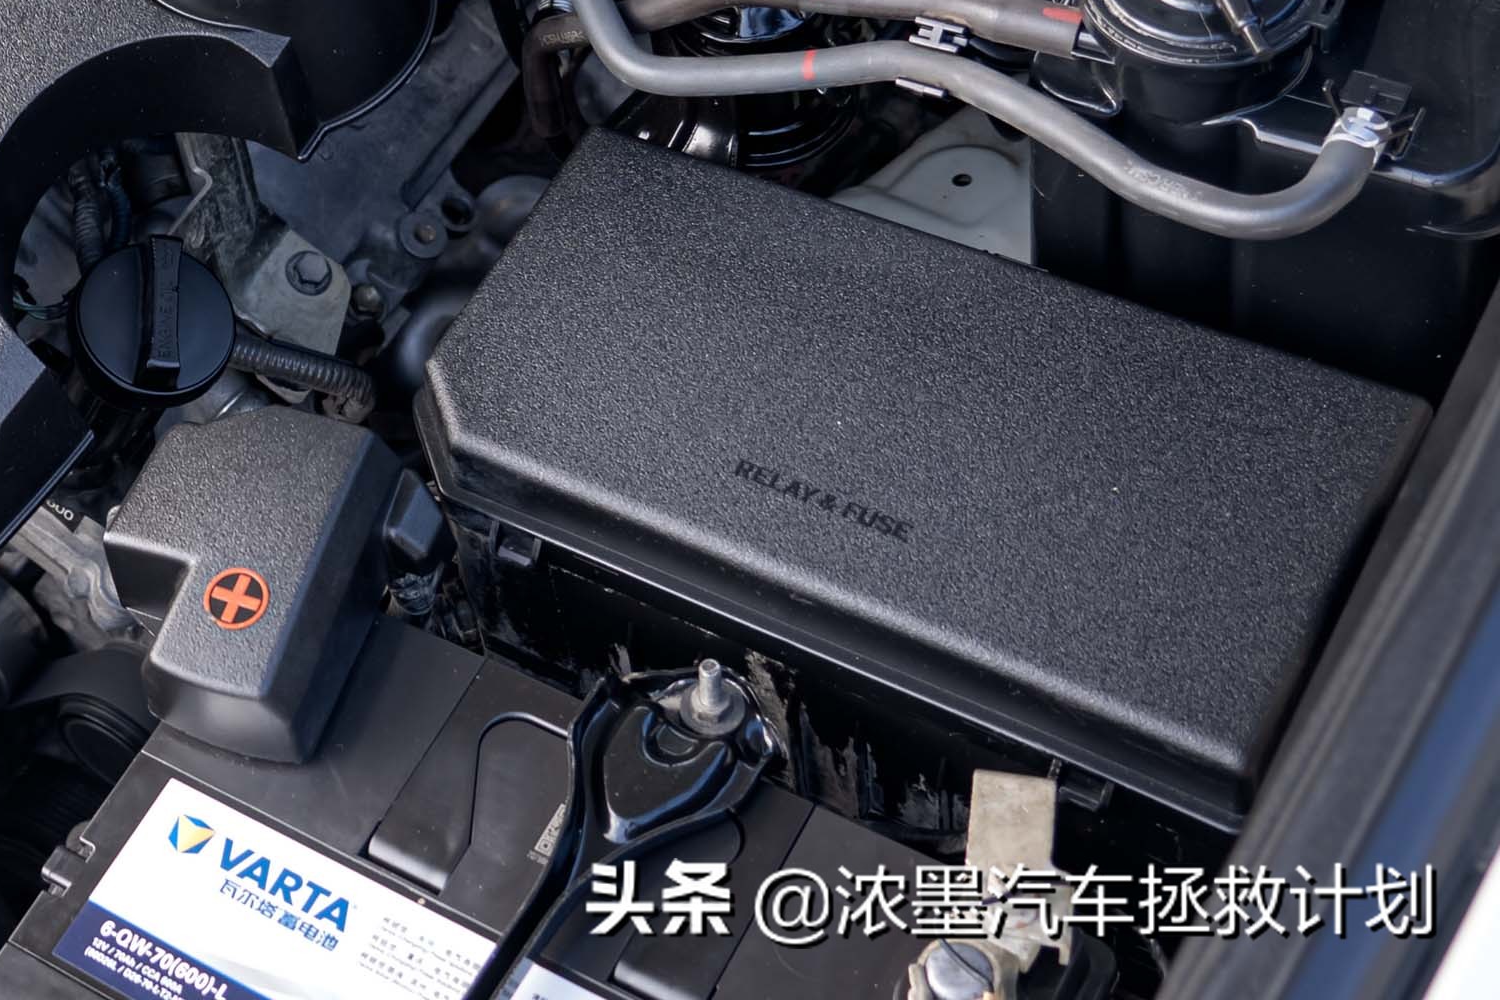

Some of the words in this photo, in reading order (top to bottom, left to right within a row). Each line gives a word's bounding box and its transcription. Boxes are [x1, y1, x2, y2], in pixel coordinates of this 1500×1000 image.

[735, 460, 820, 502] RELAY
[842, 501, 914, 544] FUSE
[220, 837, 349, 933] VARTA
[141, 965, 161, 982] CCA
